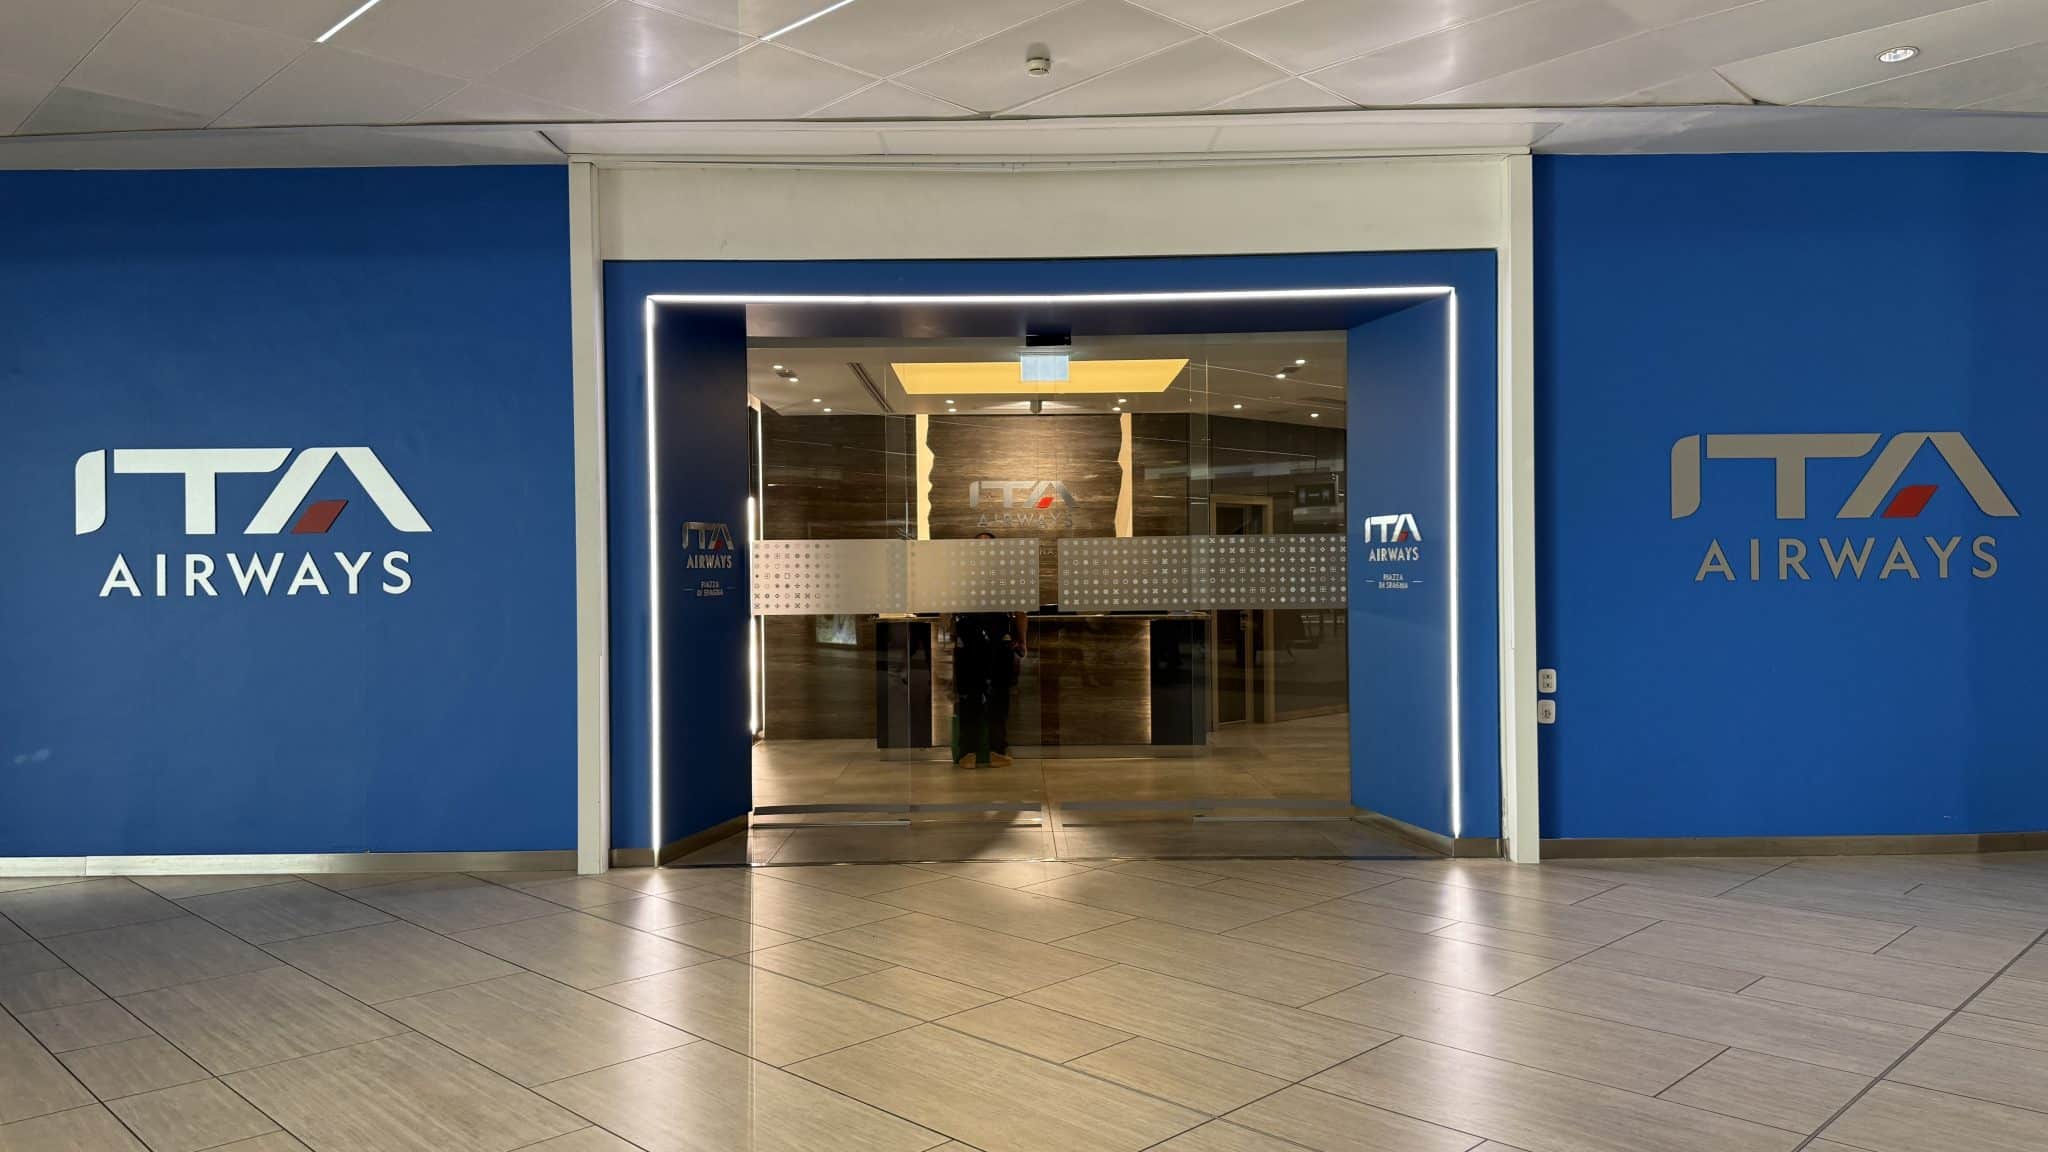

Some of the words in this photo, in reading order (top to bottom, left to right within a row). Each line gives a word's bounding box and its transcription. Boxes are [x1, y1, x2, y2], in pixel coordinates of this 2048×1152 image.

[1671, 431, 2020, 519] ITA
[75, 446, 433, 535] ITA
[969, 480, 1080, 510] ITA
[977, 512, 1073, 528] AIRWAYS
[1364, 513, 1422, 543] ITA
[682, 521, 734, 550] ITA
[686, 554, 732, 569] AIRWAYS
[1368, 546, 1420, 562] AIRWAYS
[1695, 535, 1998, 581] AIRWAYS
[99, 551, 412, 597] AIRWAYS
